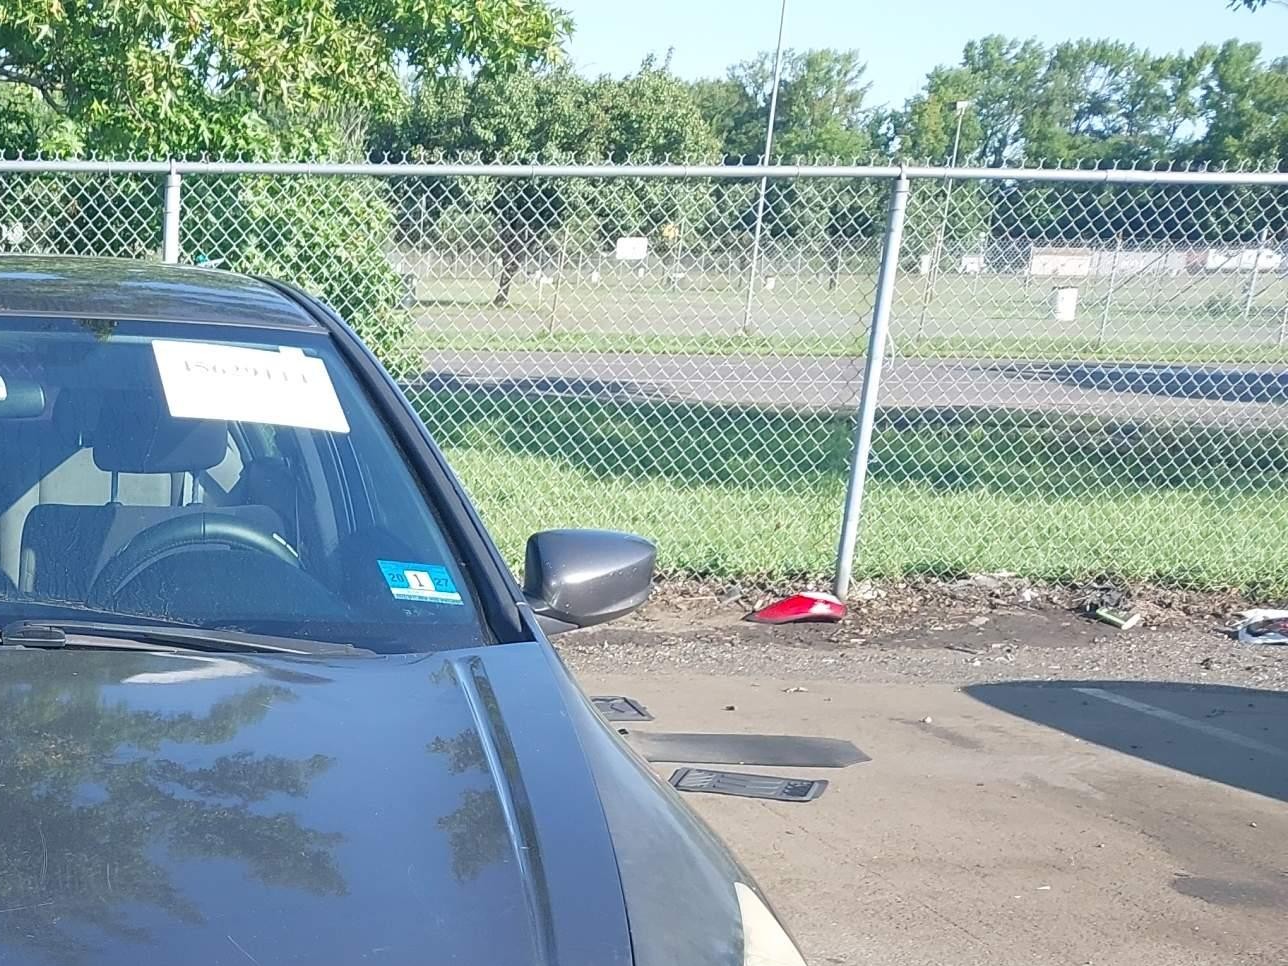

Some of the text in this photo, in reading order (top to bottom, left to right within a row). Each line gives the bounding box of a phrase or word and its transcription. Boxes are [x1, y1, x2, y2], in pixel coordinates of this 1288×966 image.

[388, 573, 449, 587] 20 1 27
